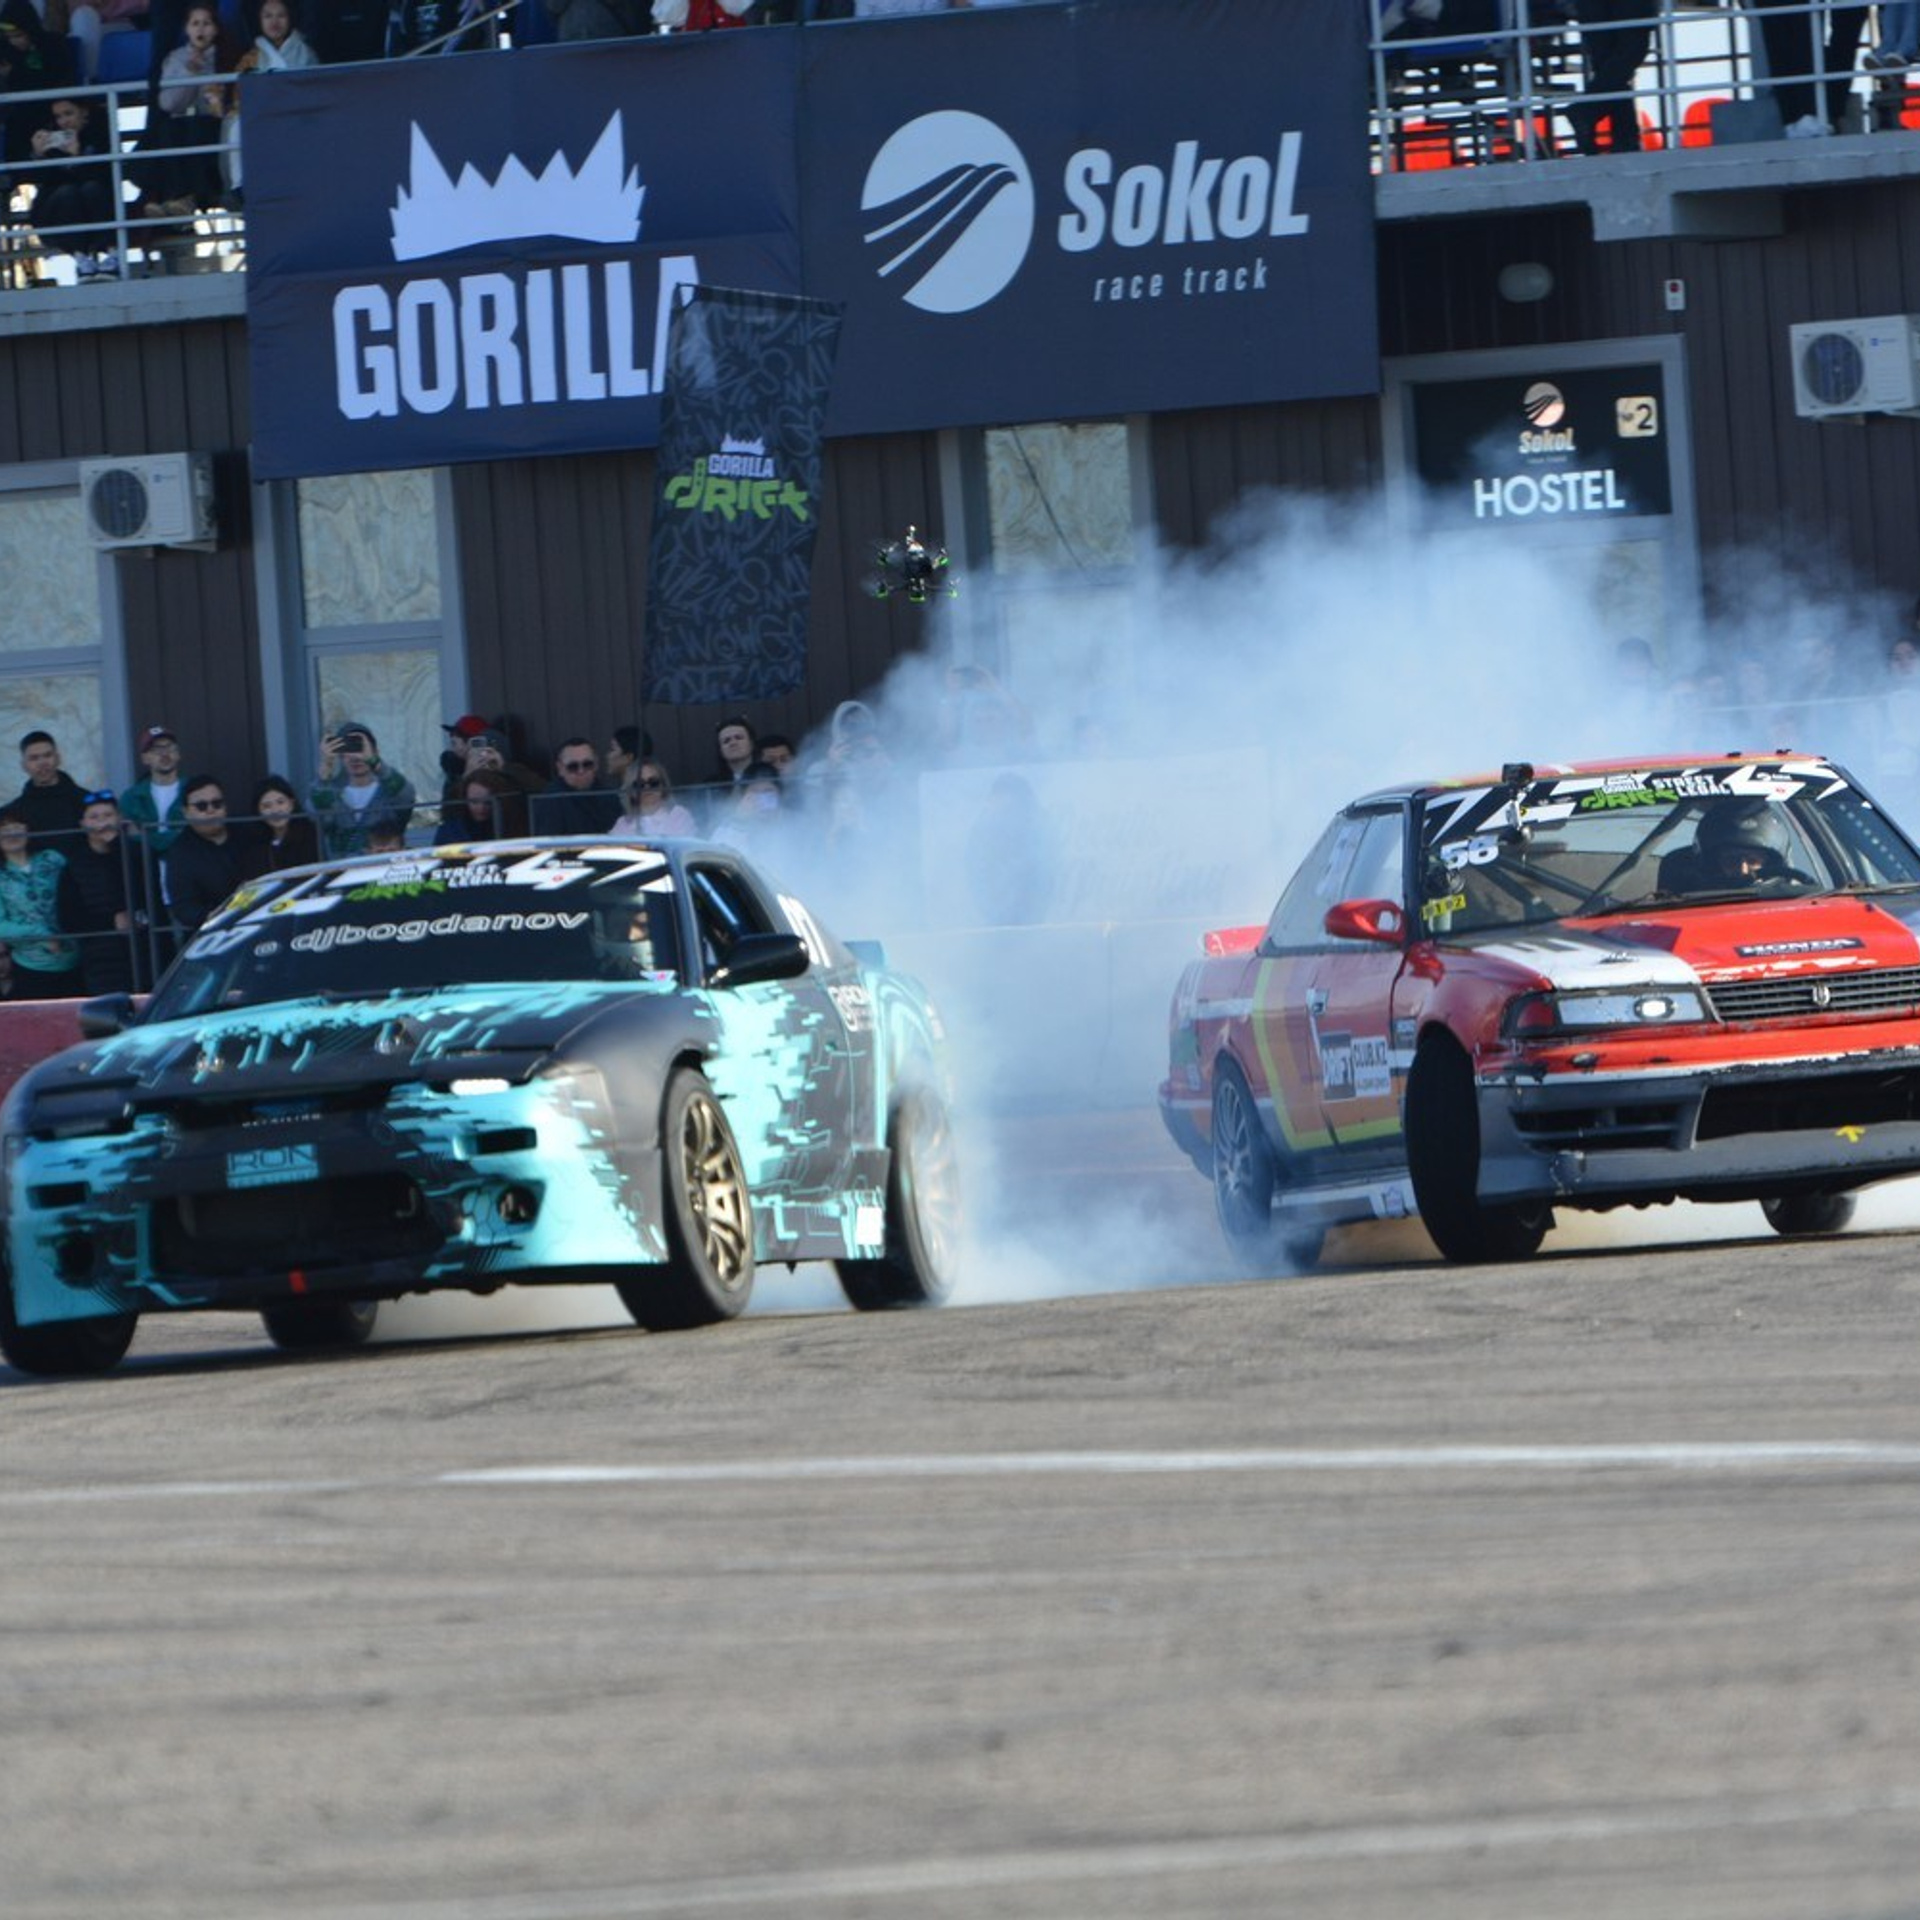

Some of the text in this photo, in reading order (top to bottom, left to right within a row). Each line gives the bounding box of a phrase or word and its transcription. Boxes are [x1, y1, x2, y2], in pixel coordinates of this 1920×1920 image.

[1093, 257, 1267, 302] race track
[708, 453, 775, 478] GORILLA
[1474, 469, 1626, 518] HOSTEL
[1652, 774, 1716, 791] STREET
[291, 911, 589, 952] djbogdanov
[1742, 938, 1857, 955] HONDA
